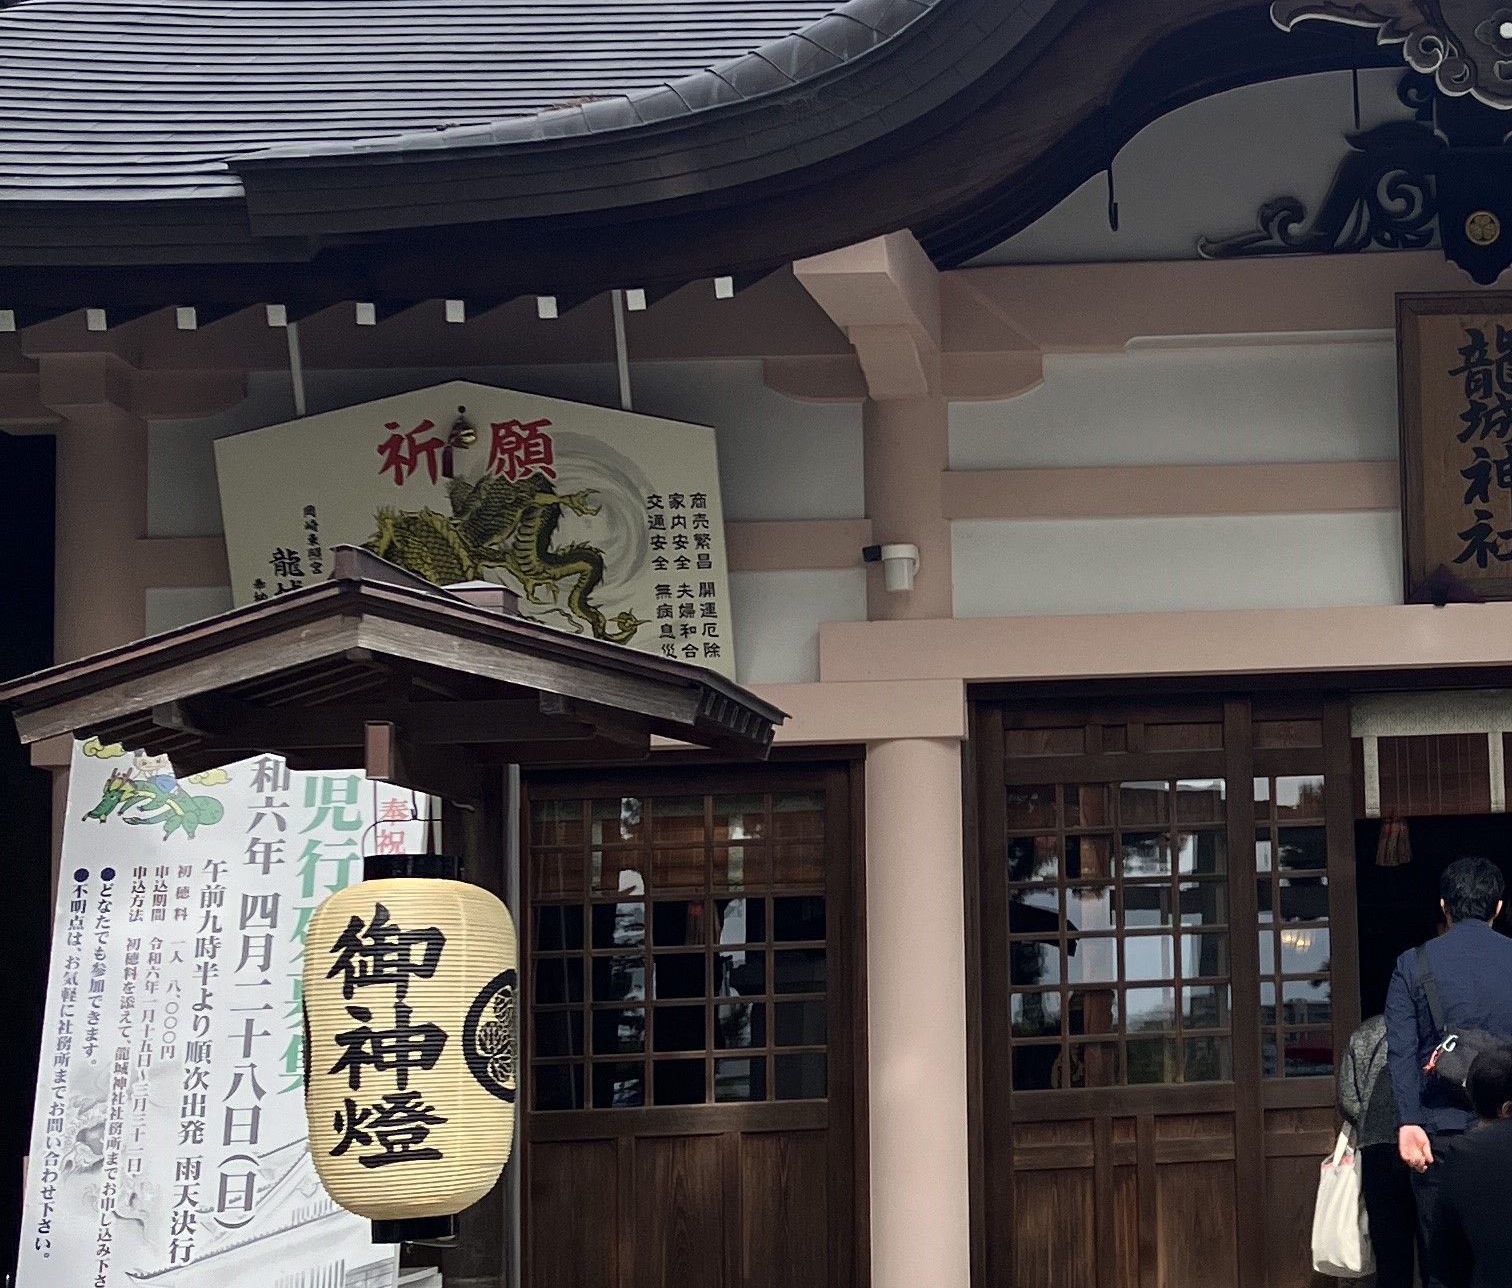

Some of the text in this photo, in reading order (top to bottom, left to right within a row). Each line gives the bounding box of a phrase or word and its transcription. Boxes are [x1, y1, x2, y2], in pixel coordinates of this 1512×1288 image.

[377, 418, 558, 486] 祈願
[647, 493, 670, 571] 交通安全
[668, 492, 699, 658] 家内安全 夫婦和合
[690, 492, 721, 658] 商売繁昌 開運厄除
[128, 866, 148, 923] 申込方法
[151, 865, 170, 922] 申込期間
[169, 859, 228, 1264] 午前九時半より順次出発 雨天決行
[326, 902, 449, 1170] 御神燈
